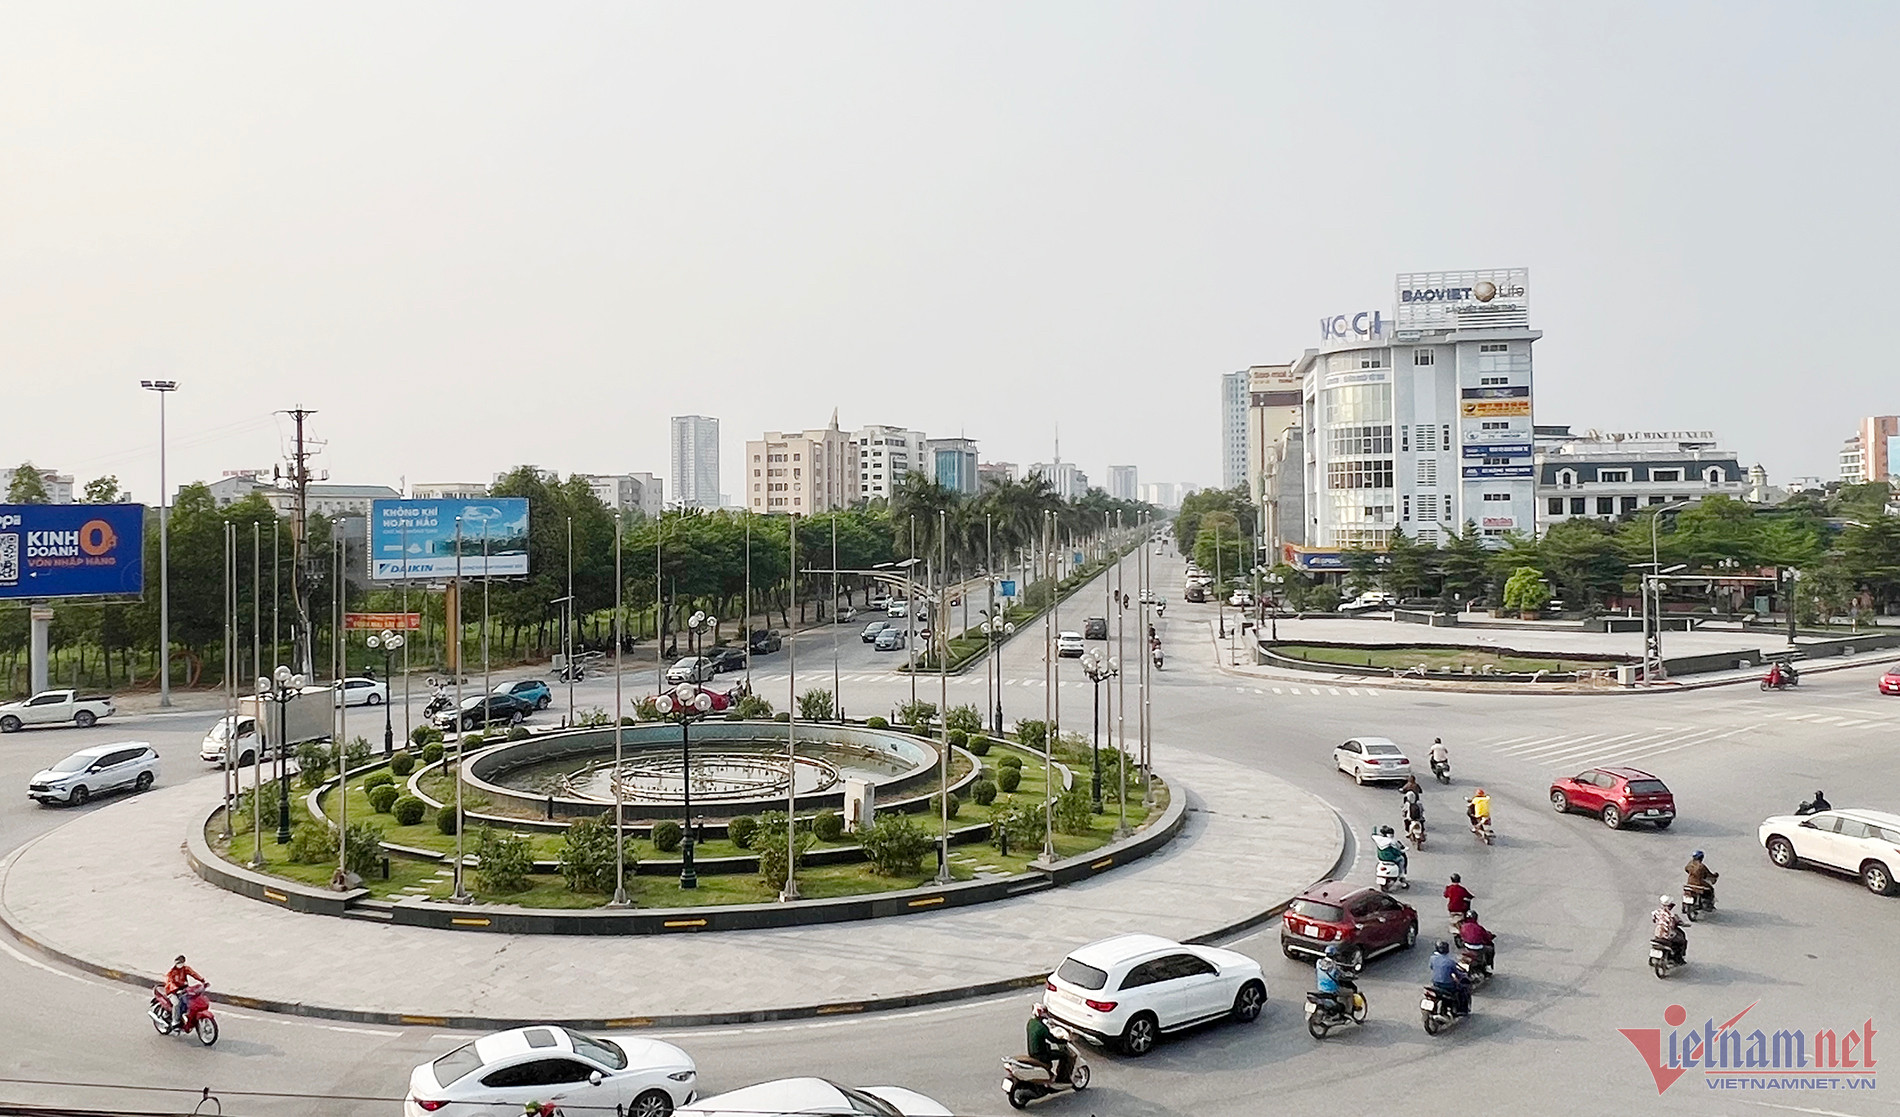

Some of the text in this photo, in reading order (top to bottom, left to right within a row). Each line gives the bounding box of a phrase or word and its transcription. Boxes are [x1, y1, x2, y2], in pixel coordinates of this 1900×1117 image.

[1402, 284, 1525, 302] BAOVIET Life
[382, 505, 420, 517] KHÔNG
[27, 531, 79, 546] KINH
[27, 546, 79, 557] DOANH
[390, 563, 434, 573] DAIKIN
